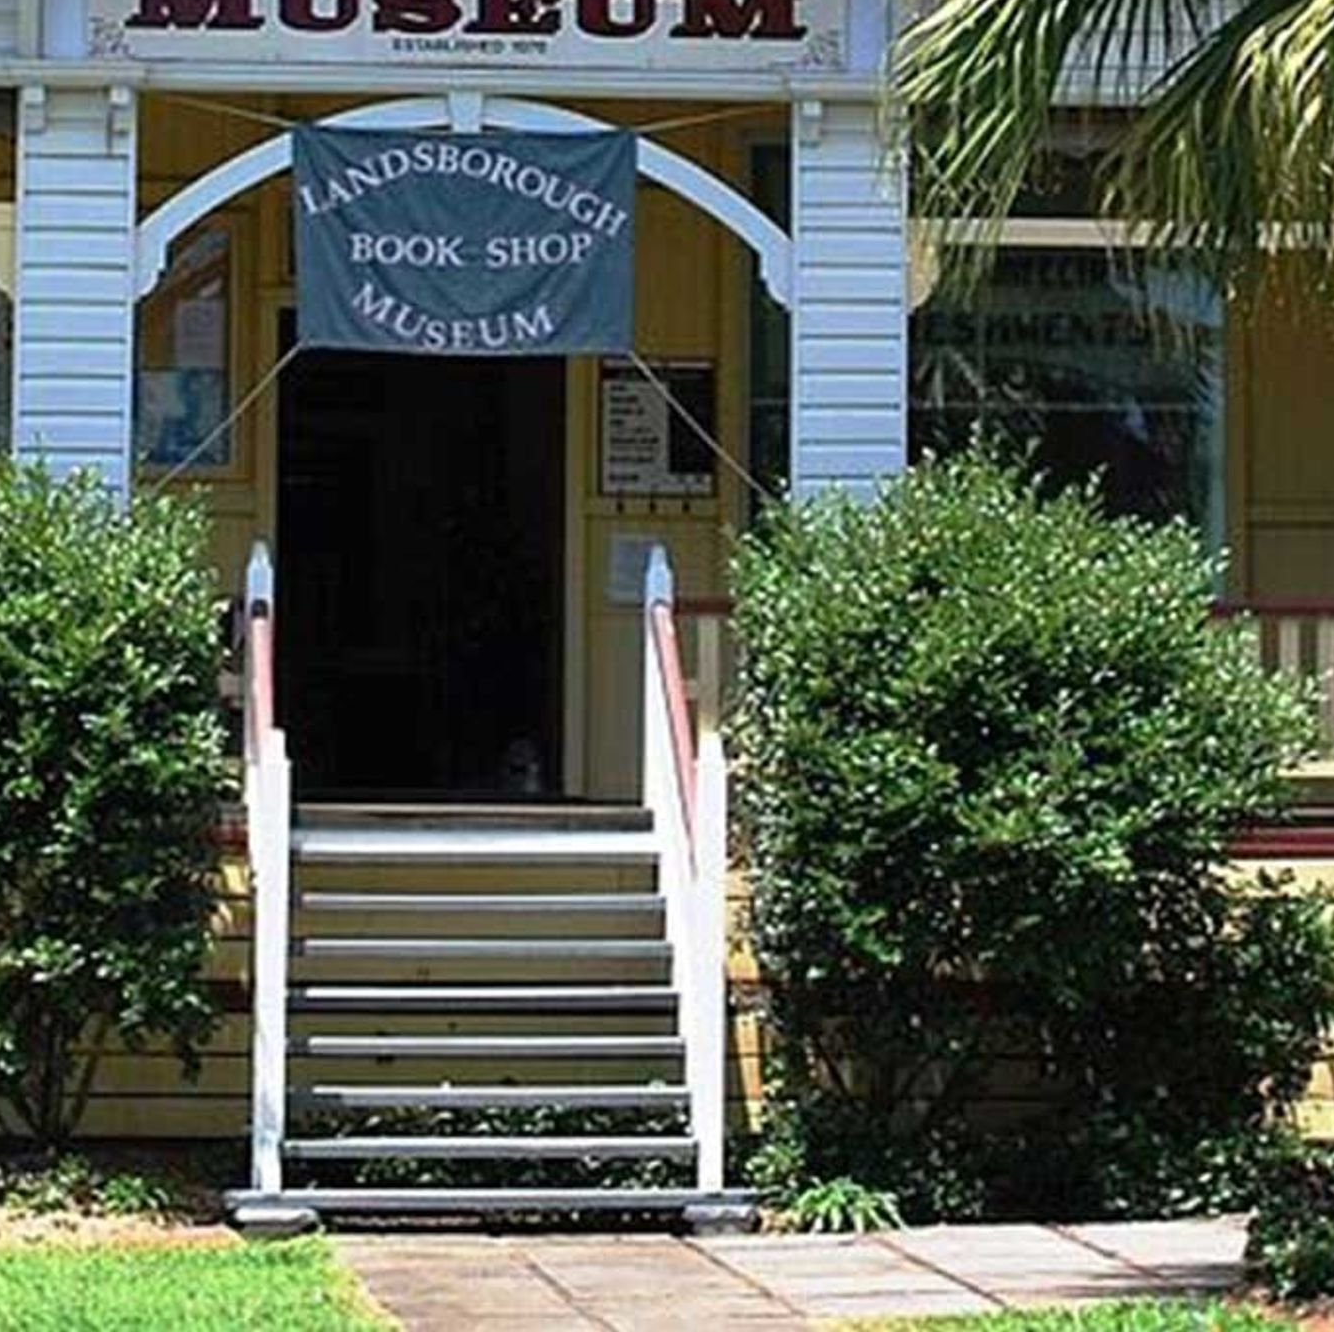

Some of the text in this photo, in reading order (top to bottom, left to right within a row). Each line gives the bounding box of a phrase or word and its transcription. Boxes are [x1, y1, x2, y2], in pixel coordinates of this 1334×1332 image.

[298, 142, 627, 237] LANDSBOROUGH
[350, 232, 592, 268] BOOK SHOP
[351, 282, 555, 350] MUSEUM
